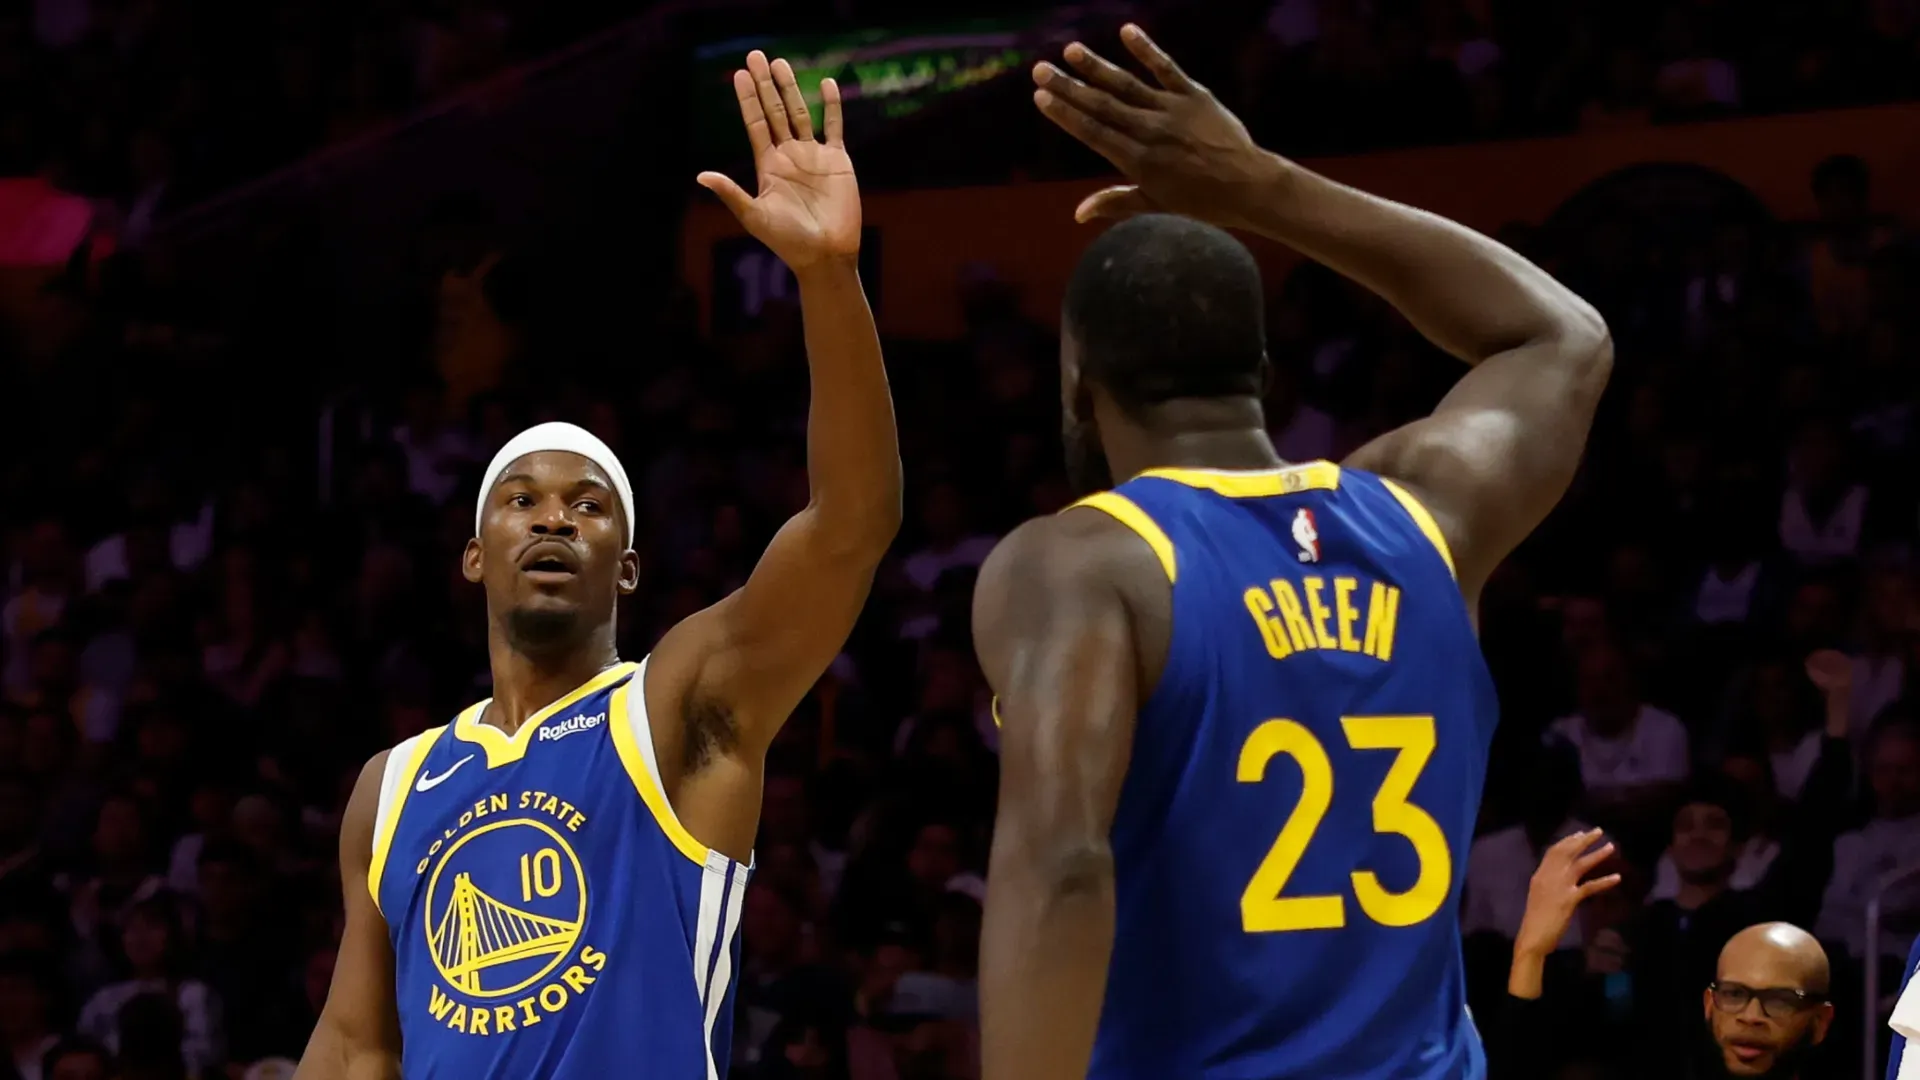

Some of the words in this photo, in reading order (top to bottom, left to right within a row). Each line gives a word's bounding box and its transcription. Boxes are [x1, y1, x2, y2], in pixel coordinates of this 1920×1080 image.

[1243, 575, 1400, 662] GREEN
[538, 711, 606, 742] Rakuten
[416, 792, 508, 875] GOLDEN
[518, 790, 588, 833] STATE
[1236, 715, 1452, 933] 23
[520, 847, 563, 903] 10
[426, 944, 607, 1036] WARRIORS
